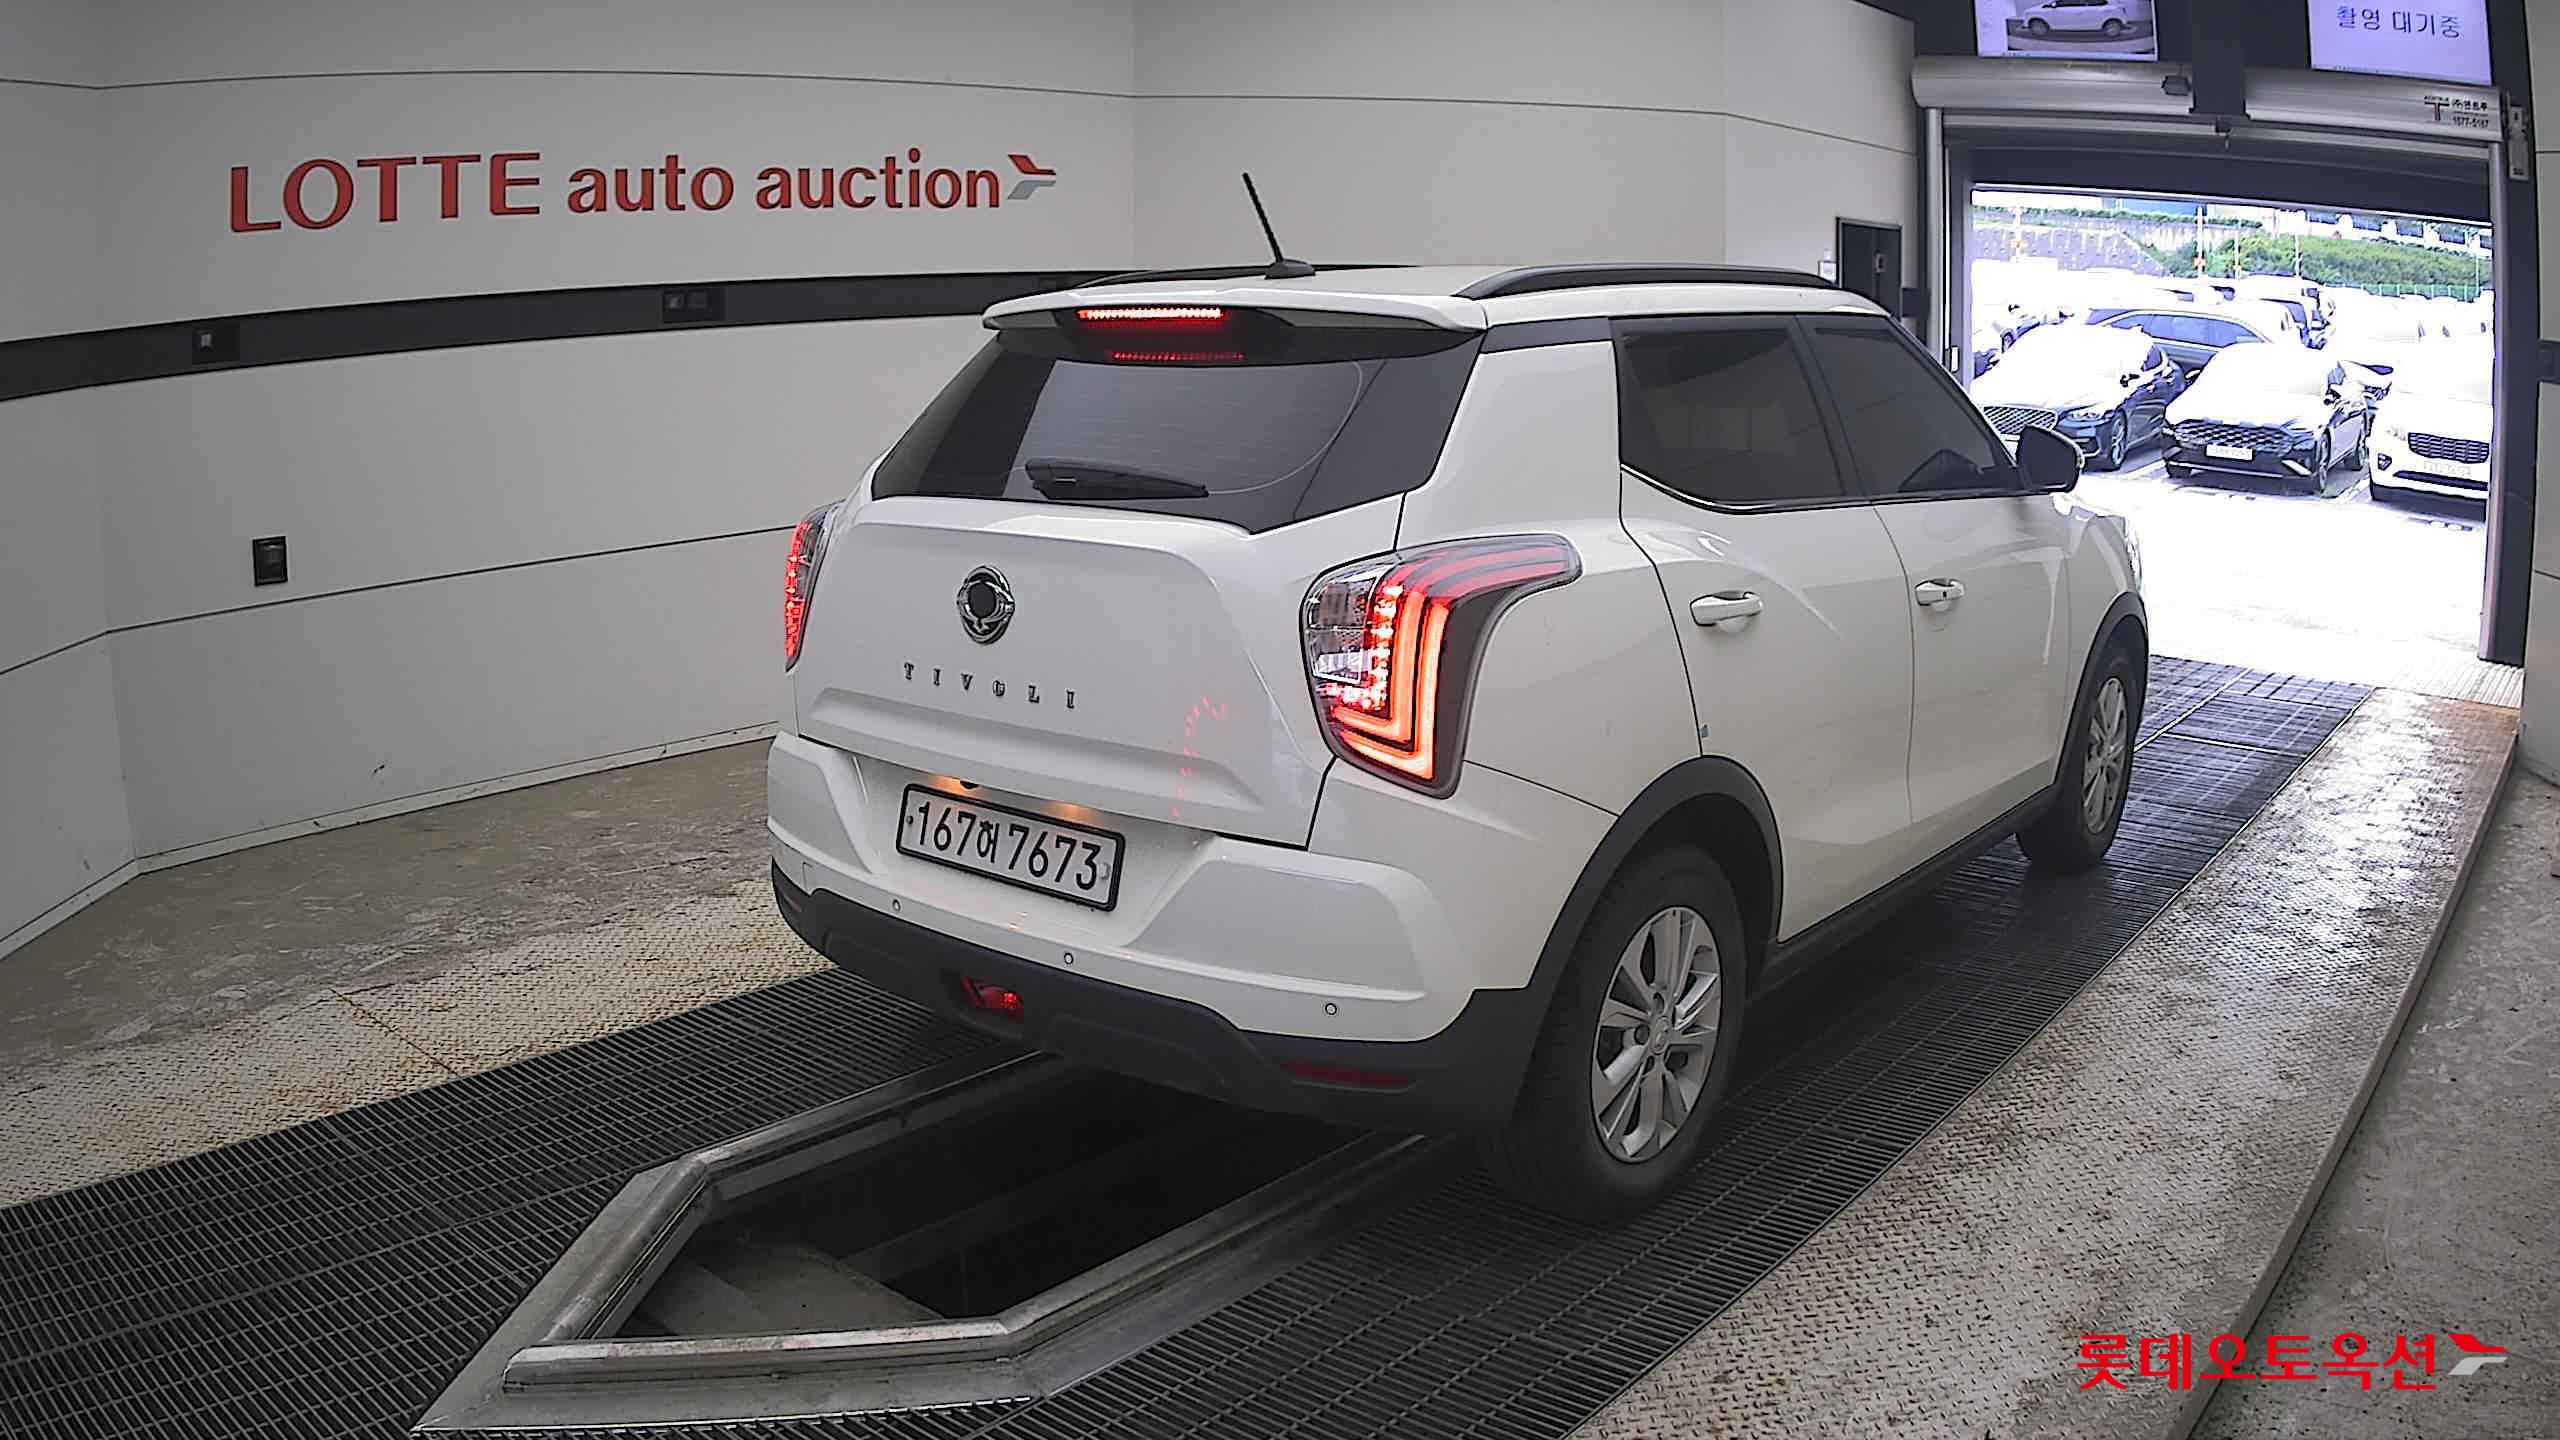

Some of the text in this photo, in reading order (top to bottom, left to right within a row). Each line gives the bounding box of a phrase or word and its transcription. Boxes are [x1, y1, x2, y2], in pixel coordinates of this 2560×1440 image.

[2392, 10, 2461, 39] 대기중
[229, 147, 1001, 233] LOTTE auto auction
[903, 661, 1077, 710] TIVOLI
